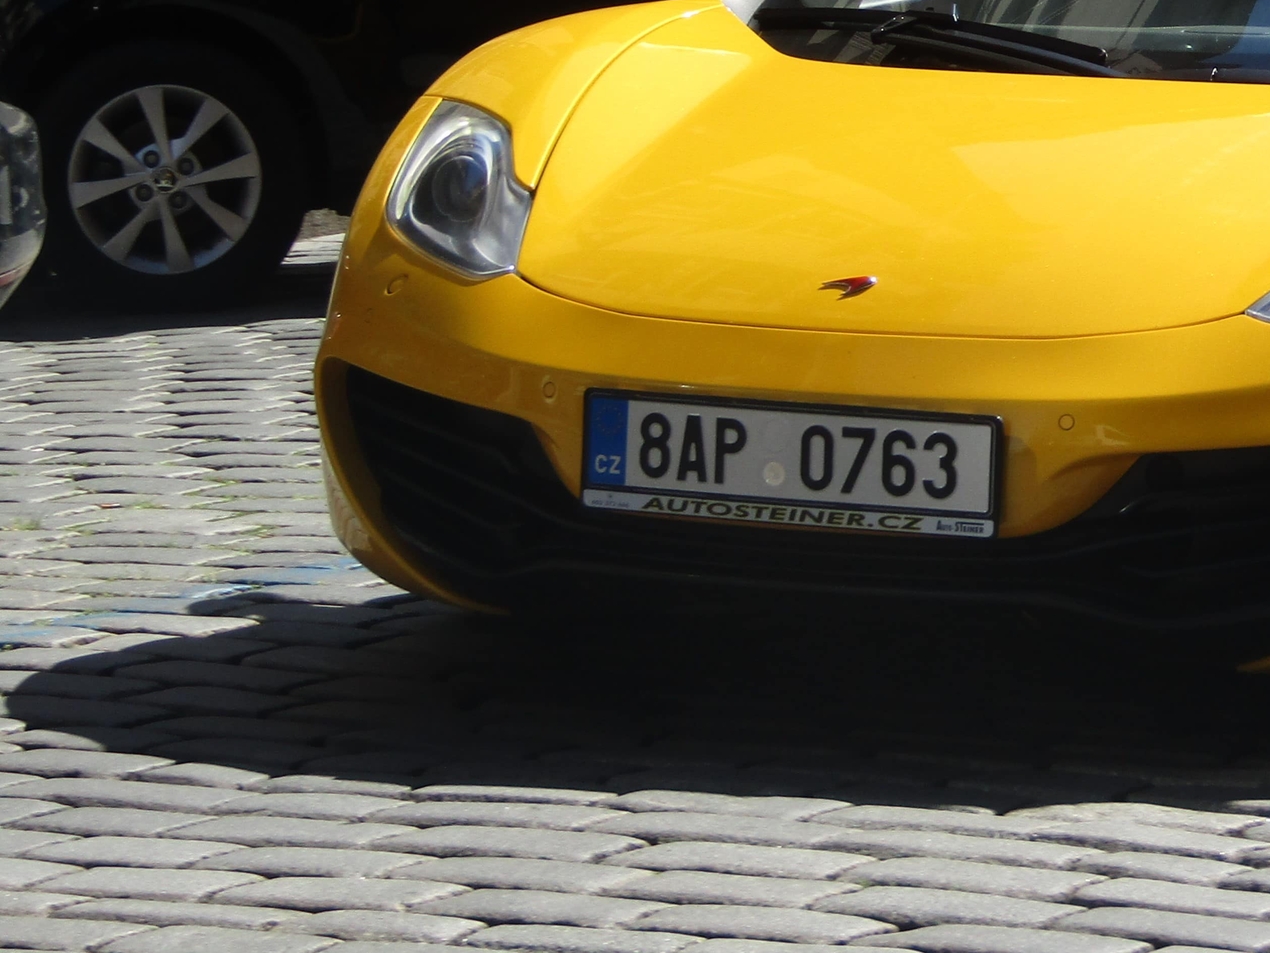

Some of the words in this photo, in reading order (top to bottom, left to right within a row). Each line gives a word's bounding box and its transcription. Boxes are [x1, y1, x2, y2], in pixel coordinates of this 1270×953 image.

[594, 454, 622, 475] CZ
[638, 413, 747, 484] 8AP
[800, 425, 958, 499] 0763
[642, 497, 924, 531] AUTOSTEINER.CZ
